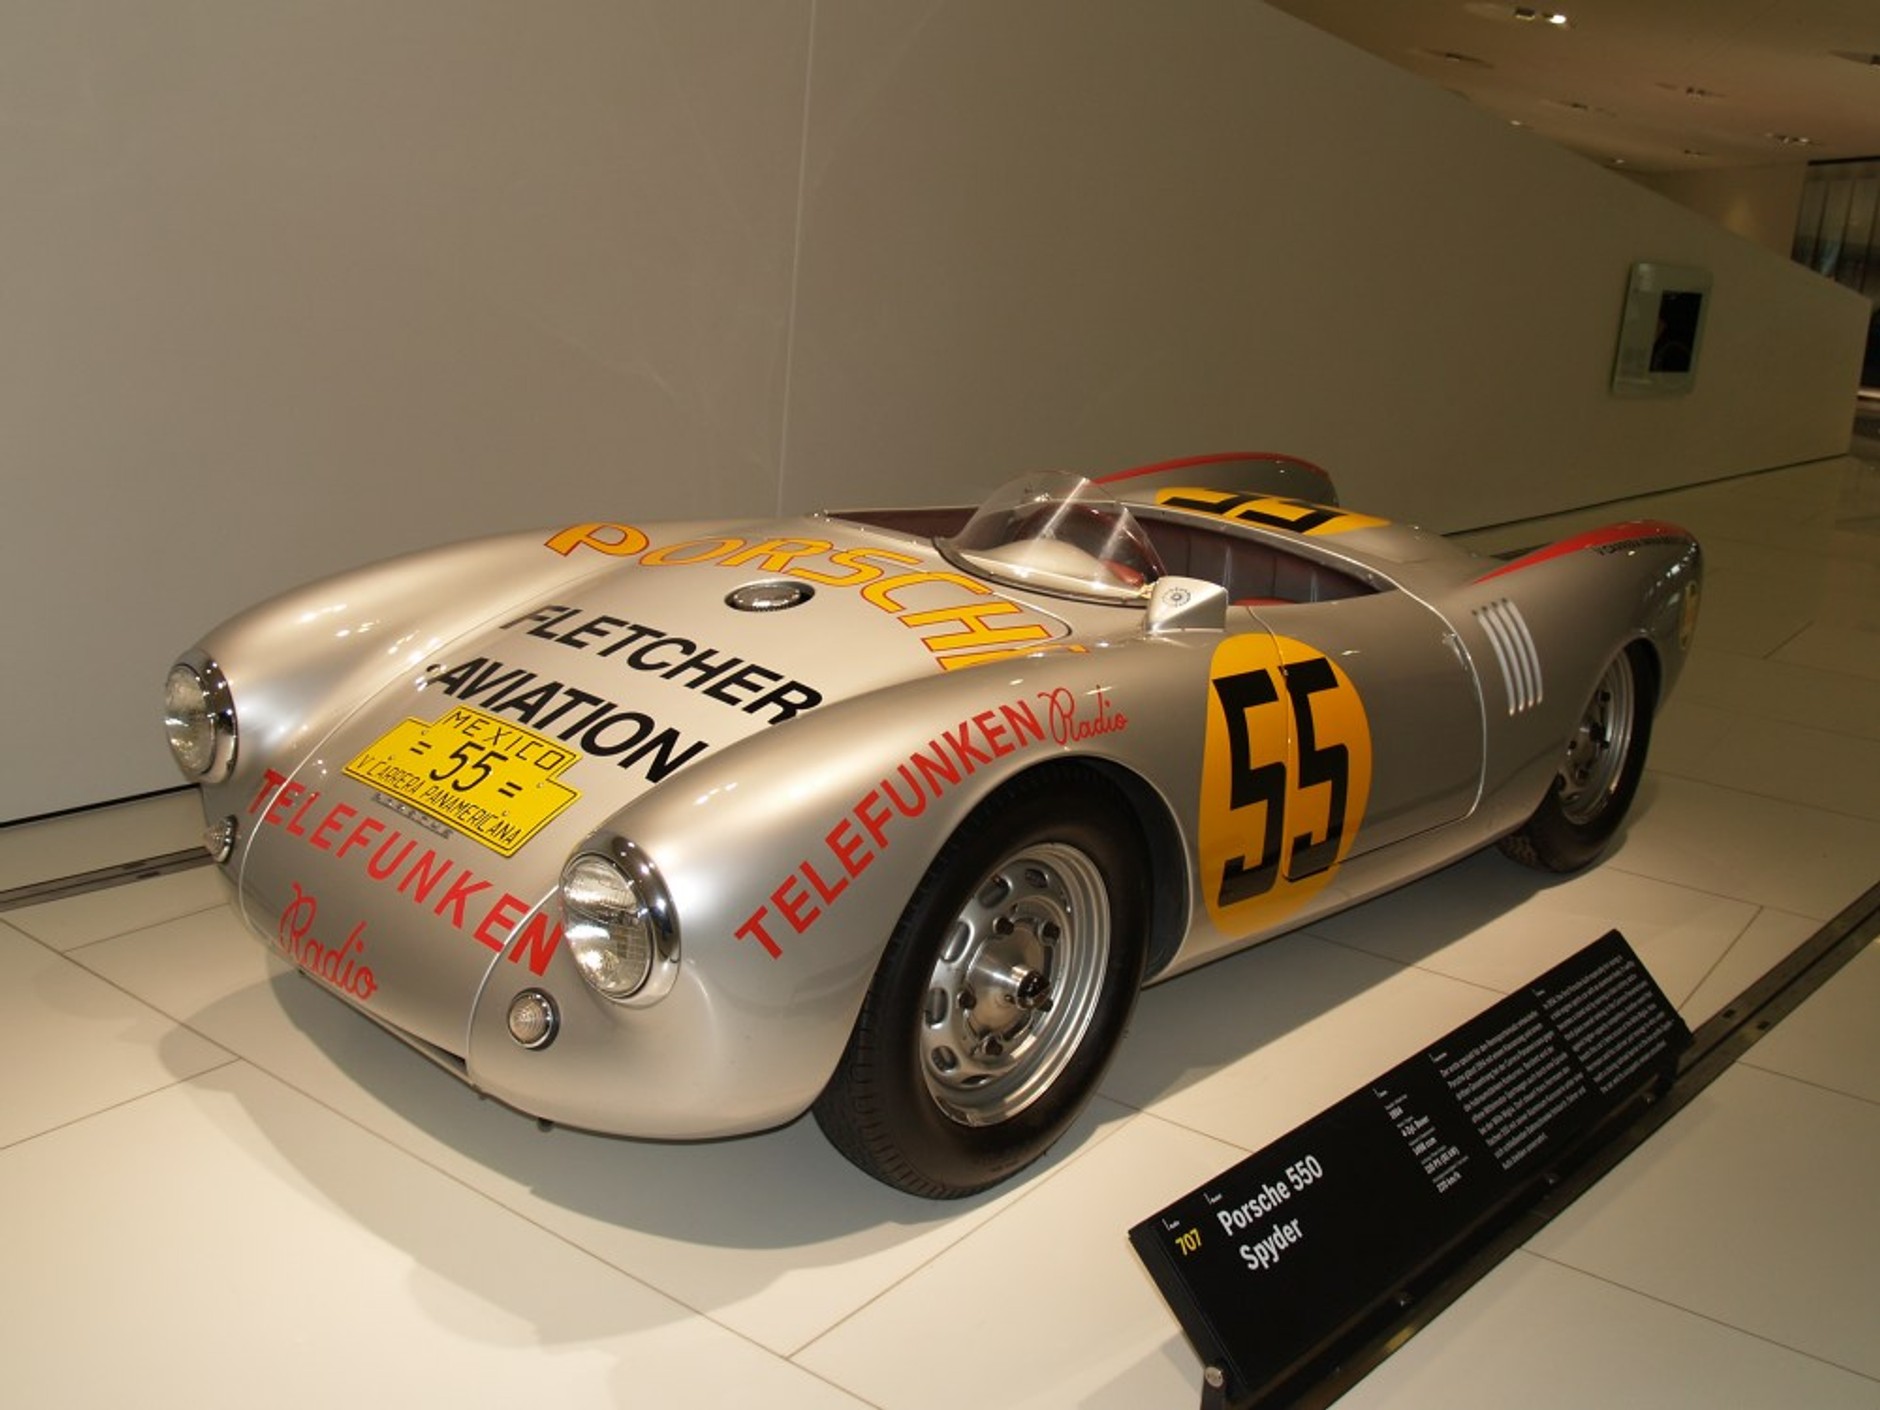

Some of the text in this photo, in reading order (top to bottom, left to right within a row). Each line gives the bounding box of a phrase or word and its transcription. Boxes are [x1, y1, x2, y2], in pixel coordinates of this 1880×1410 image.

[499, 604, 823, 726] FLETCHER
[425, 656, 710, 784] AVIATION
[429, 740, 509, 792] 55
[450, 711, 566, 772] MEXICO
[357, 754, 370, 769] V
[369, 755, 426, 793] CARRERA
[422, 785, 522, 845] PANAMERICANA
[733, 683, 1130, 960] TELEFUNKEN Radio
[1211, 656, 1350, 908] 55
[249, 767, 564, 977] TELEFUNKEN
[279, 881, 378, 1000] Radio
[1175, 1228, 1202, 1256] 707
[1216, 1154, 1323, 1236] Porsche 550
[1239, 1218, 1303, 1270] Spyder
